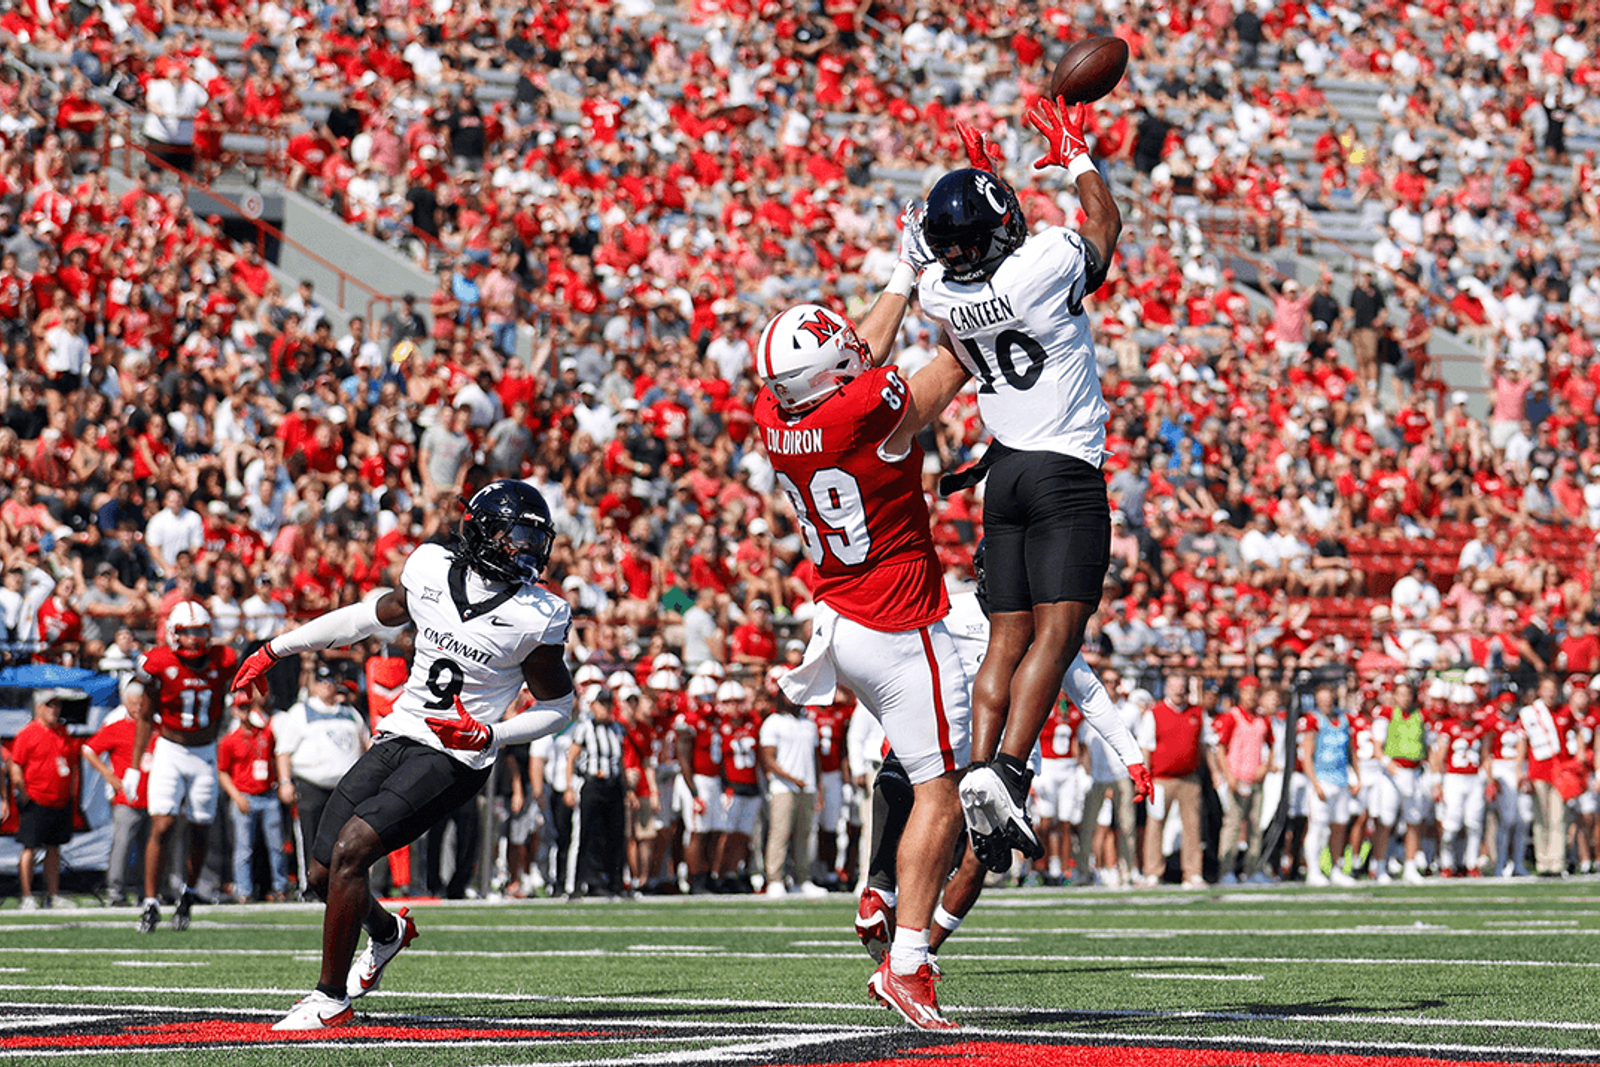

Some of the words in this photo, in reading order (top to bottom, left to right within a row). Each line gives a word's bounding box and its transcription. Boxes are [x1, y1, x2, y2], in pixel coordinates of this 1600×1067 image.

[799, 309, 842, 347] M
[950, 294, 1015, 331] CANTEEN
[961, 329, 1049, 394] 10
[881, 370, 905, 411] 89
[776, 467, 871, 567] 89
[424, 627, 493, 665] CINCINNATI
[424, 658, 464, 710] 9
[180, 688, 213, 728] 11
